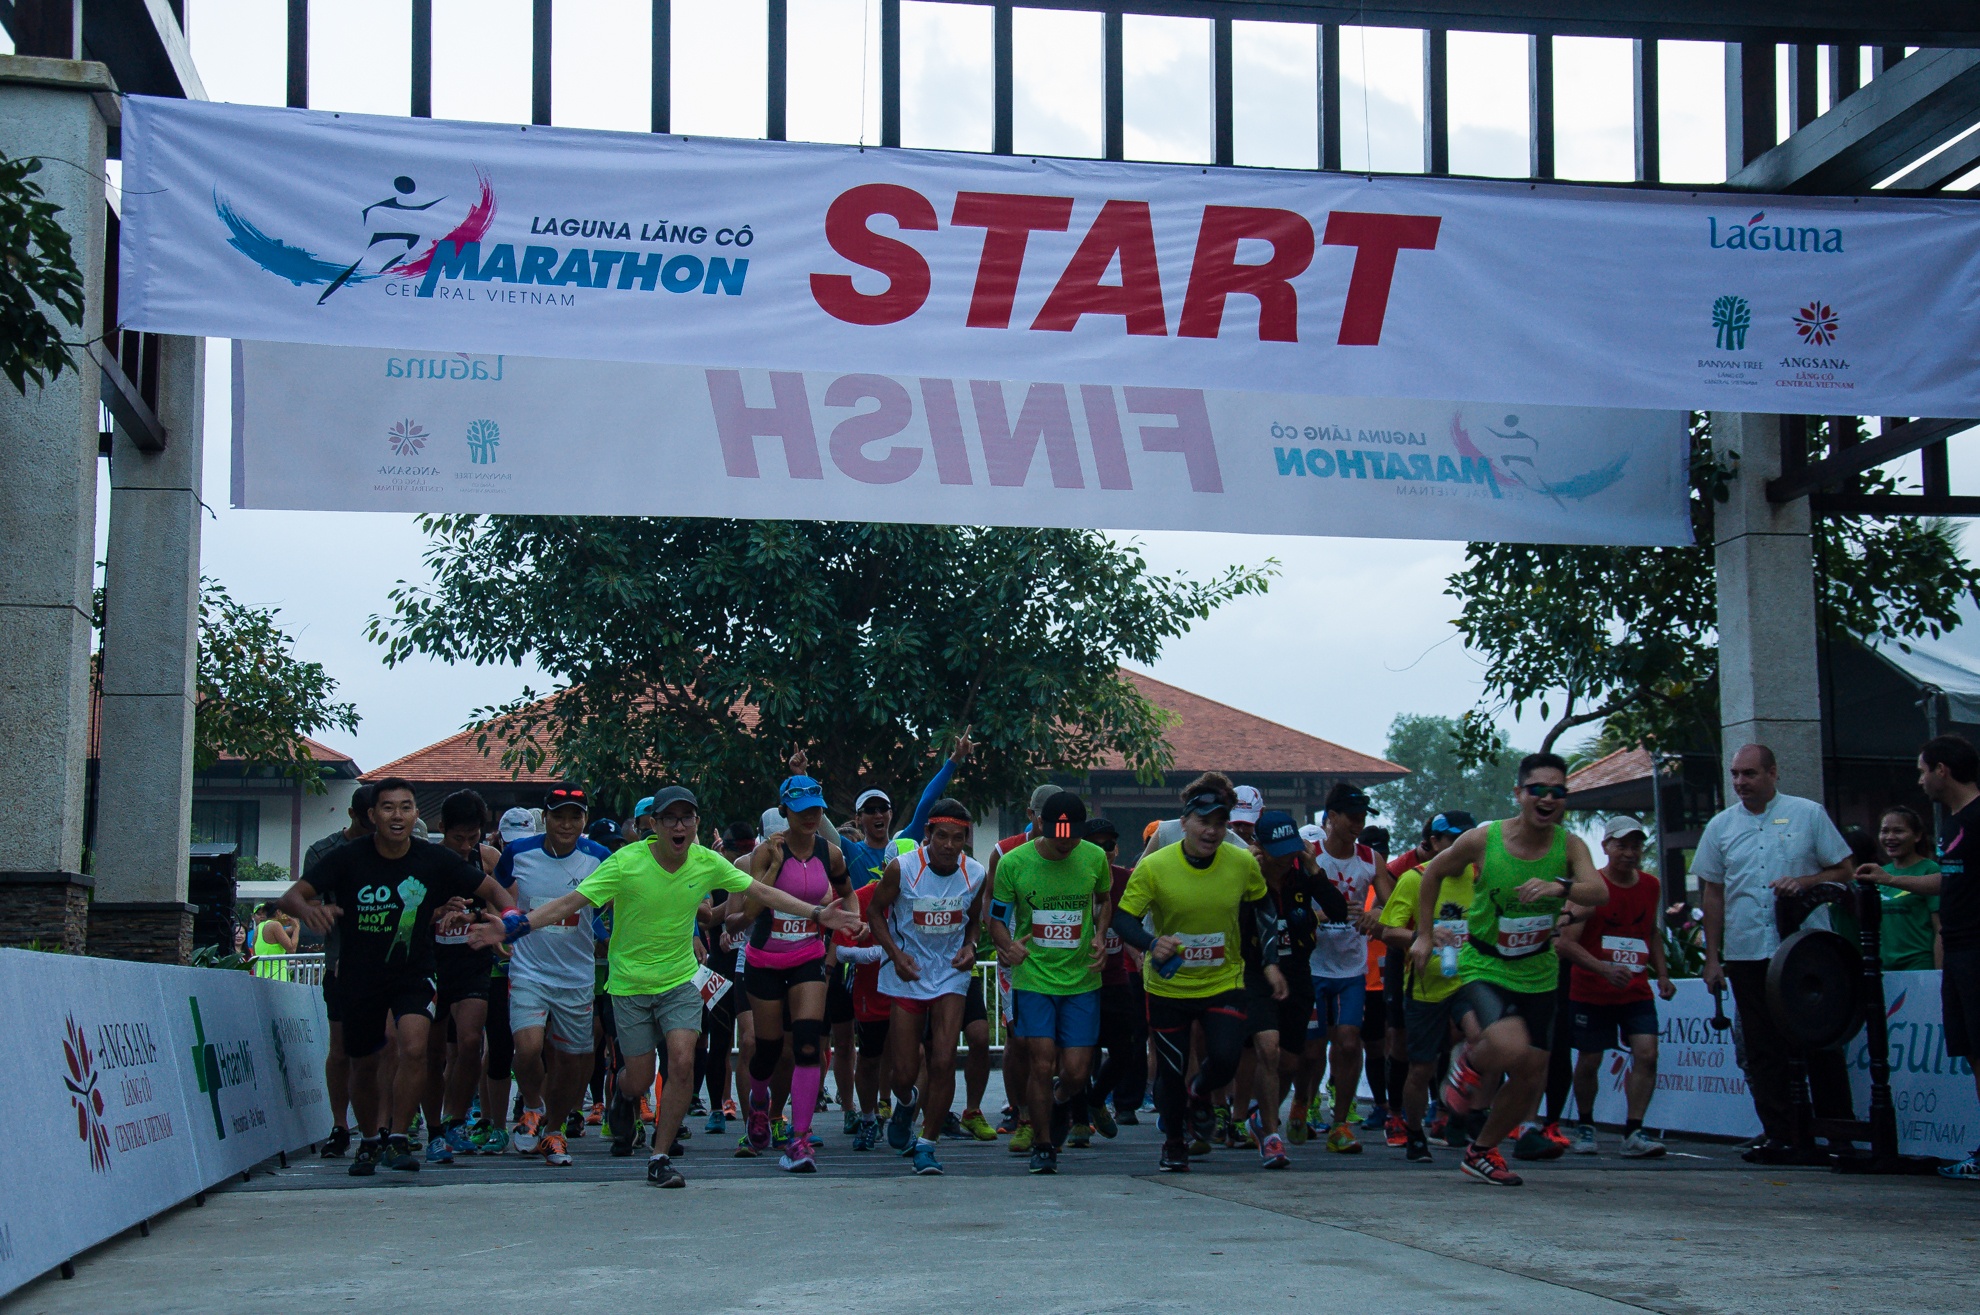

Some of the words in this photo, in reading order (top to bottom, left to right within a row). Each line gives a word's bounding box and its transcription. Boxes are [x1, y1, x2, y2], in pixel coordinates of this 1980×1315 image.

[530, 216, 632, 241] LAGUNA
[640, 219, 708, 245] LĂNG
[715, 224, 754, 247] CÔ
[417, 240, 750, 298] MARATHON
[809, 183, 1442, 346] START
[486, 288, 576, 307] VIETNAM
[1697, 359, 1741, 369] BANYAN
[1743, 360, 1764, 370] TREE
[1779, 357, 1850, 370] ANGSANA
[1796, 371, 1820, 380] LĂNG
[1775, 380, 1814, 388] CENTRAL
[1816, 380, 1855, 390] VIETNAM
[1271, 824, 1294, 840] ANTA
[357, 884, 392, 904] GO
[1042, 895, 1060, 903] LONG
[1042, 900, 1089, 911] RUNNERS
[358, 910, 391, 925] NOT
[924, 912, 952, 926] 069
[782, 920, 807, 933] 061
[1043, 925, 1072, 939] 028
[1507, 932, 1539, 947] 047
[1184, 947, 1213, 960] 049
[1612, 950, 1639, 964] 020
[98, 1022, 157, 1069] ANGSANA
[1677, 1047, 1706, 1067] LĂNG
[1707, 1047, 1725, 1068] CÔ
[1655, 1073, 1694, 1092] ENTRAL
[1698, 1075, 1746, 1095] VIETNAM
[115, 1119, 147, 1153] CENTRAL
[144, 1112, 173, 1143] VIETNAM
[1902, 1120, 1966, 1145] VIETNAM
